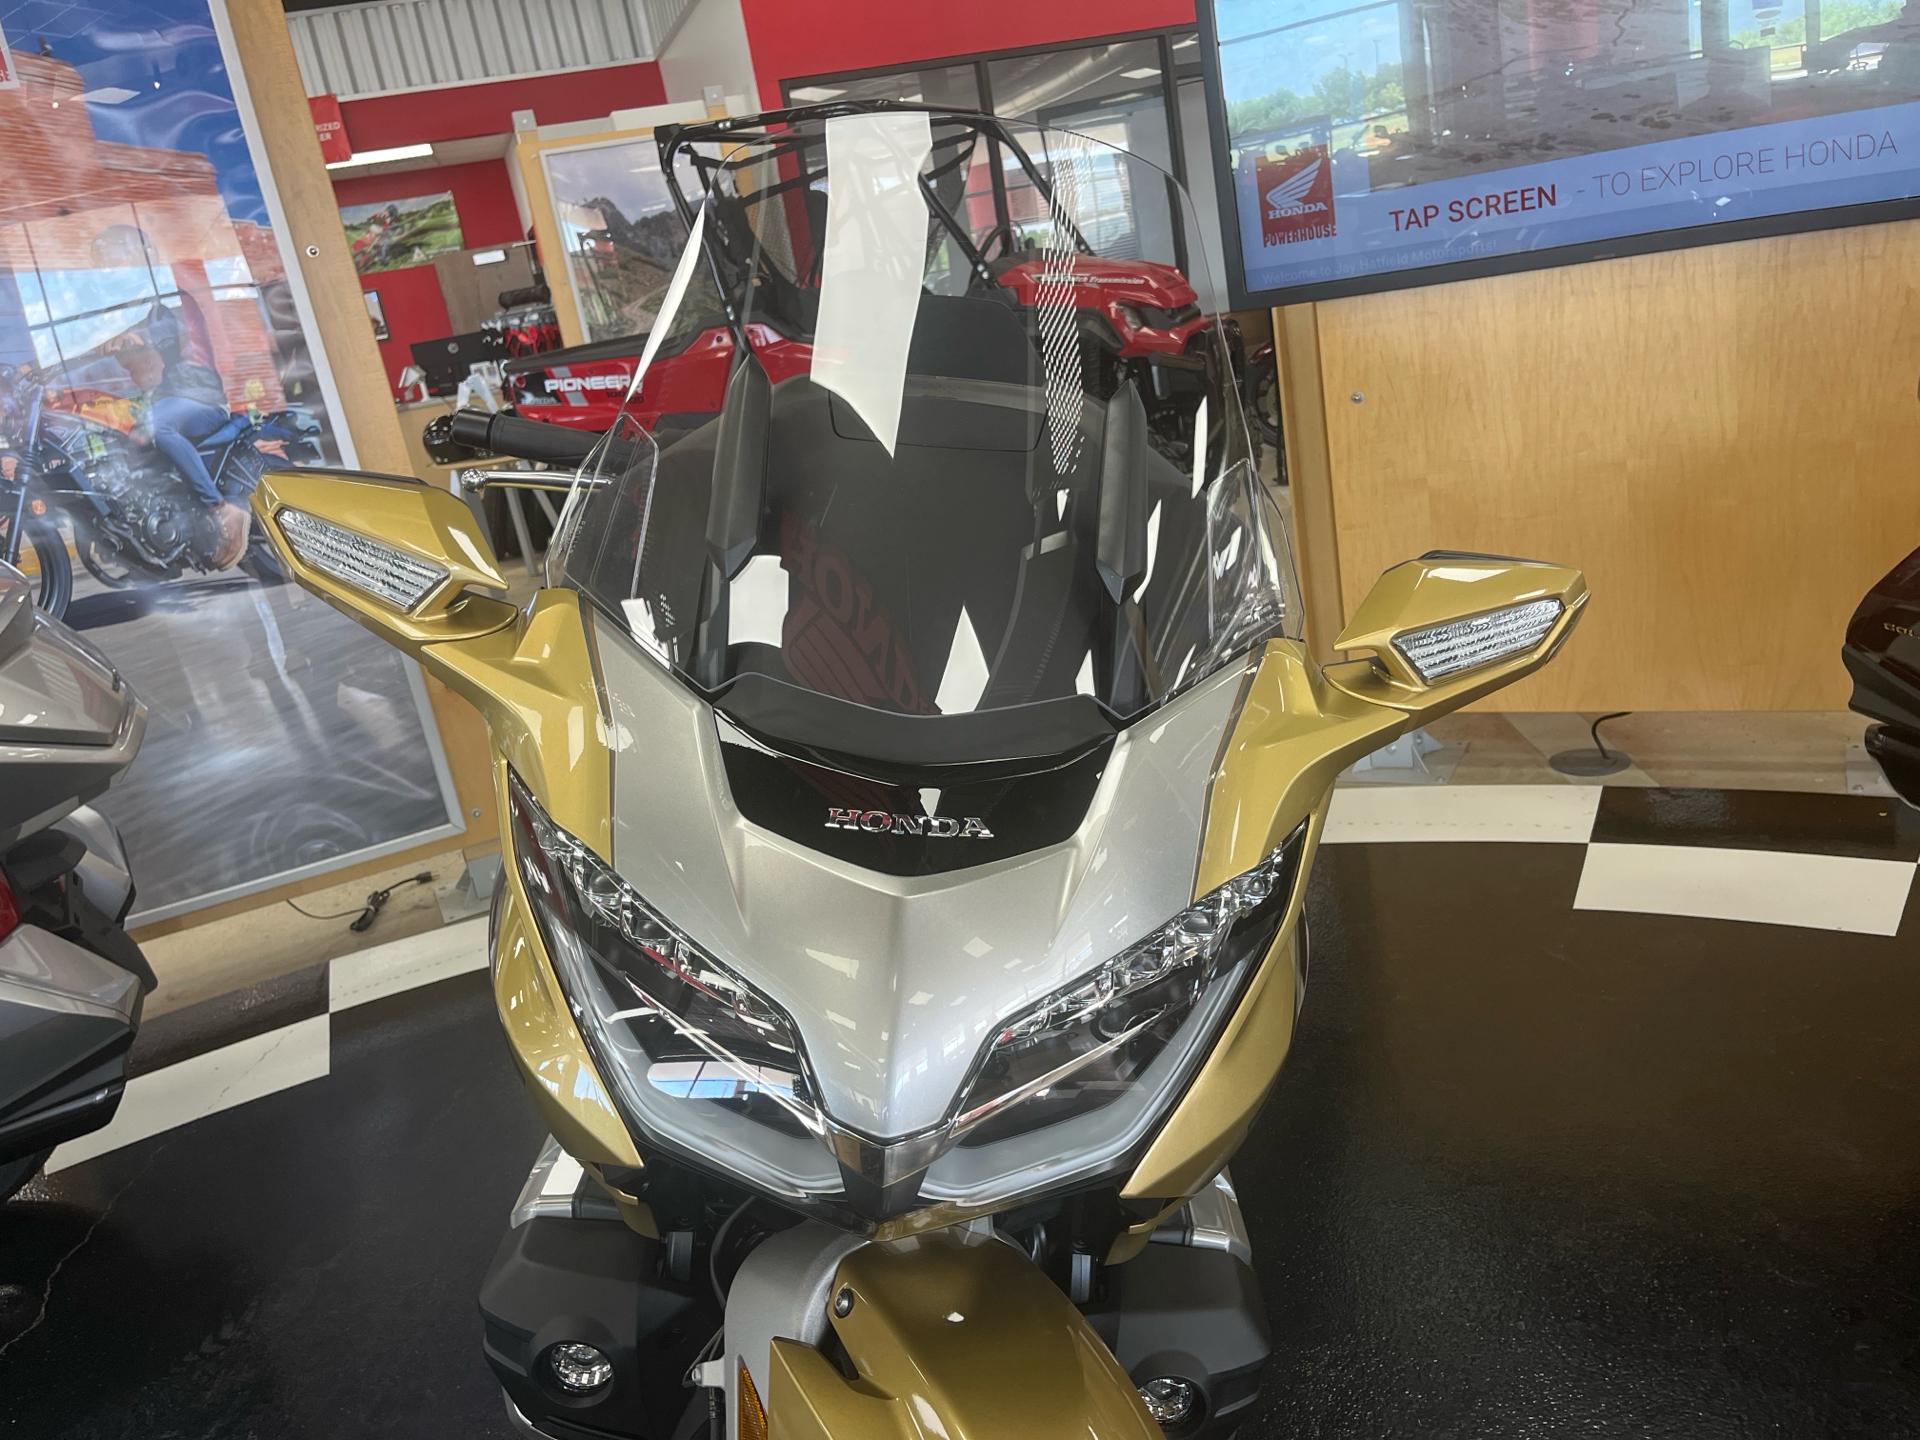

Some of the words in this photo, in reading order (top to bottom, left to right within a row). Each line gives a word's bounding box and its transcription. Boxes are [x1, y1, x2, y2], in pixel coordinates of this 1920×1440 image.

[1389, 204, 1439, 231] TAP
[1448, 184, 1557, 222] SCREEN
[1592, 171, 1631, 198] TO
[1641, 149, 1775, 192] EXPLORE
[1786, 131, 1898, 170] HONDA
[1268, 202, 1328, 219] HONDA
[1263, 224, 1337, 248] POWERHOUSE
[1262, 269, 1317, 286] Welcome
[1321, 264, 1332, 276] to
[1335, 259, 1356, 276] Jay
[1360, 251, 1409, 271] Hatfield
[1411, 239, 1497, 263] Motorsports!
[544, 374, 642, 393] PIONEER
[1883, 622, 1920, 640] GOL
[825, 807, 995, 839] HONDA
